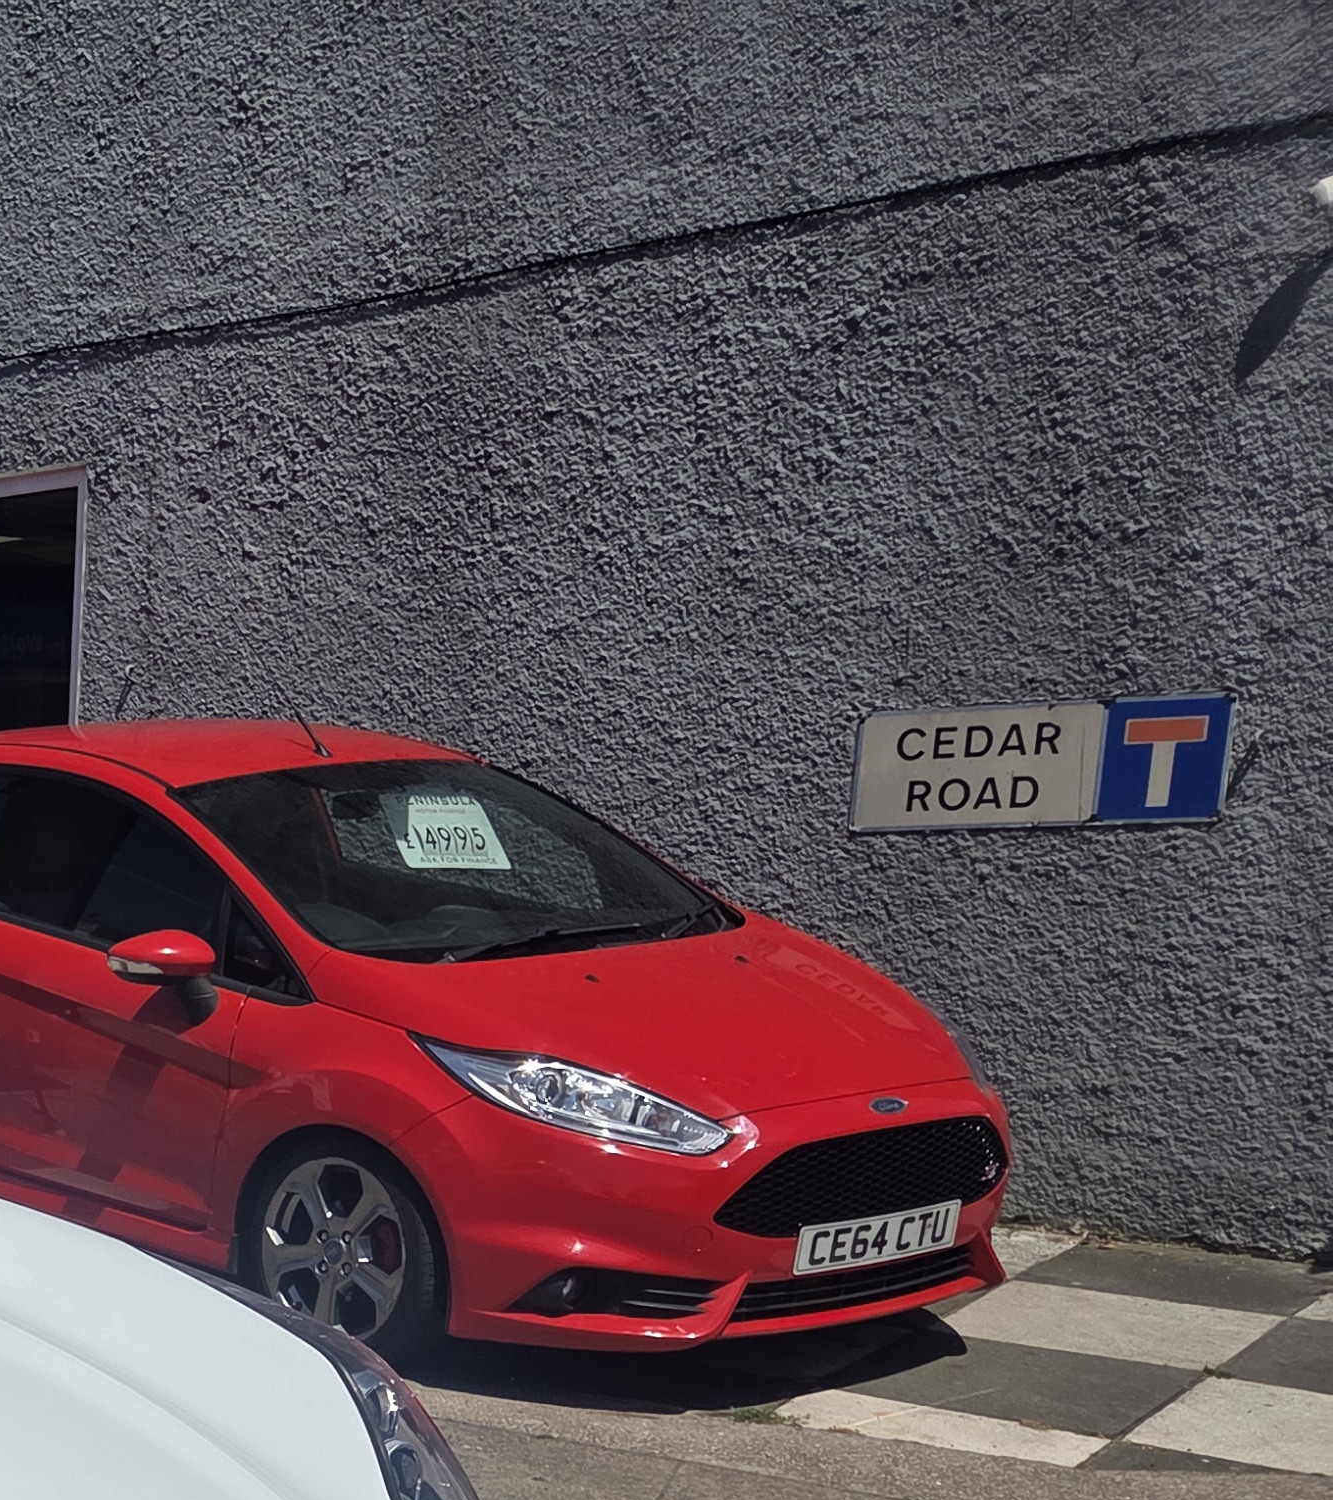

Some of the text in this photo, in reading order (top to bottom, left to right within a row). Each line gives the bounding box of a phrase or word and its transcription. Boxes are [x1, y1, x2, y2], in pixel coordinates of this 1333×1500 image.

[897, 722, 1061, 761] CEDAR
[906, 775, 1040, 812] ROAD
[425, 826, 486, 851] 4995
[808, 1208, 951, 1266] CE64 CTU
